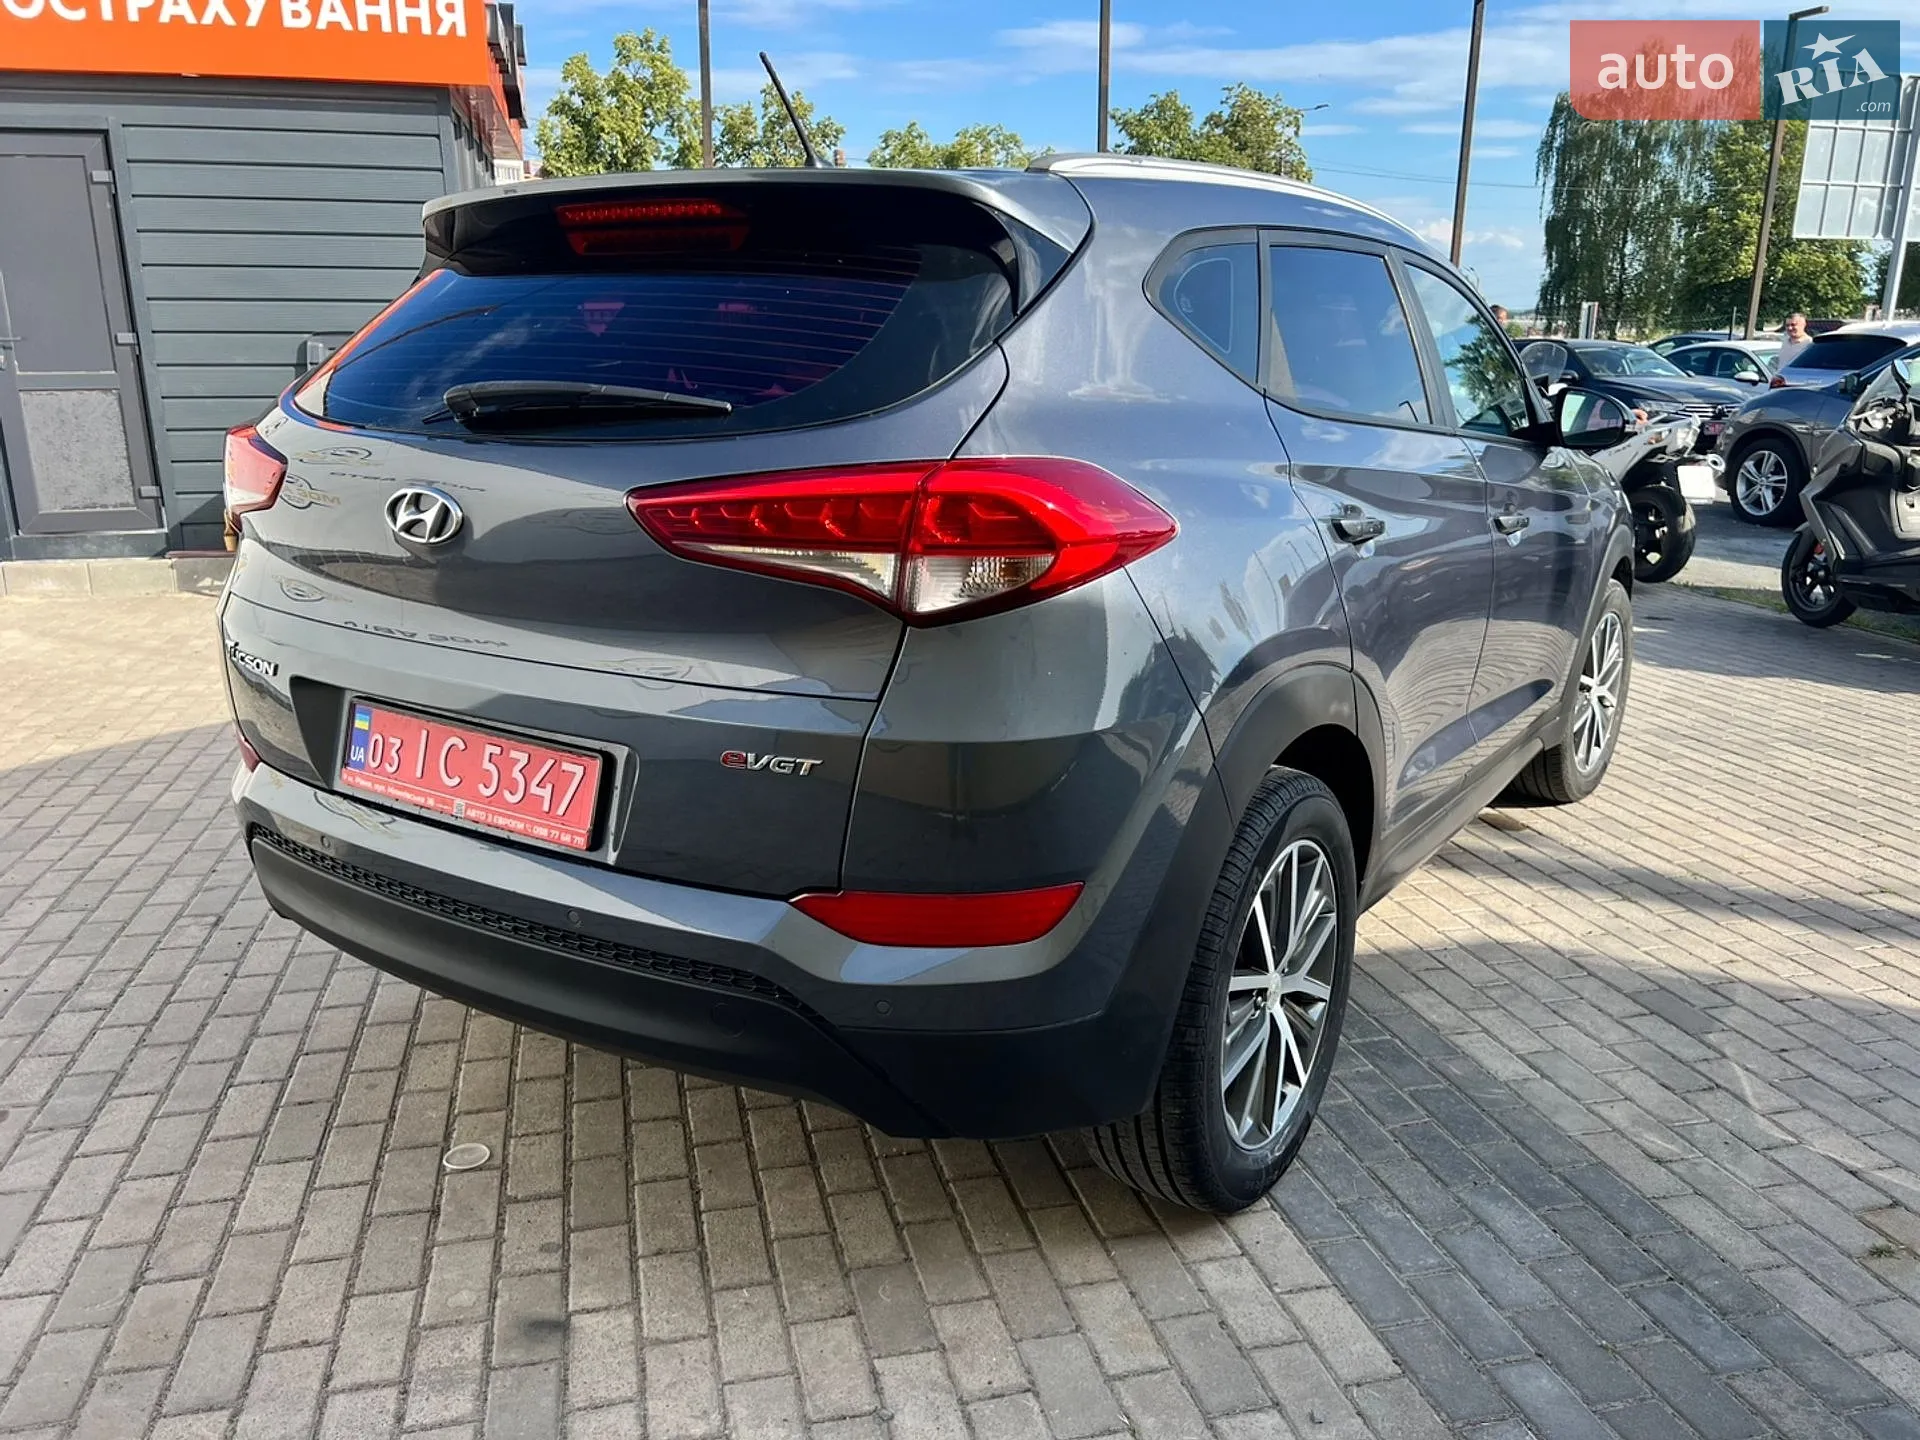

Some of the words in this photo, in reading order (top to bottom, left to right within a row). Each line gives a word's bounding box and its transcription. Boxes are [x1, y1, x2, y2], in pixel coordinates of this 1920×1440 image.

[350, 745, 364, 763] UA
[368, 733, 402, 774] 03
[478, 743, 586, 816] 5347
